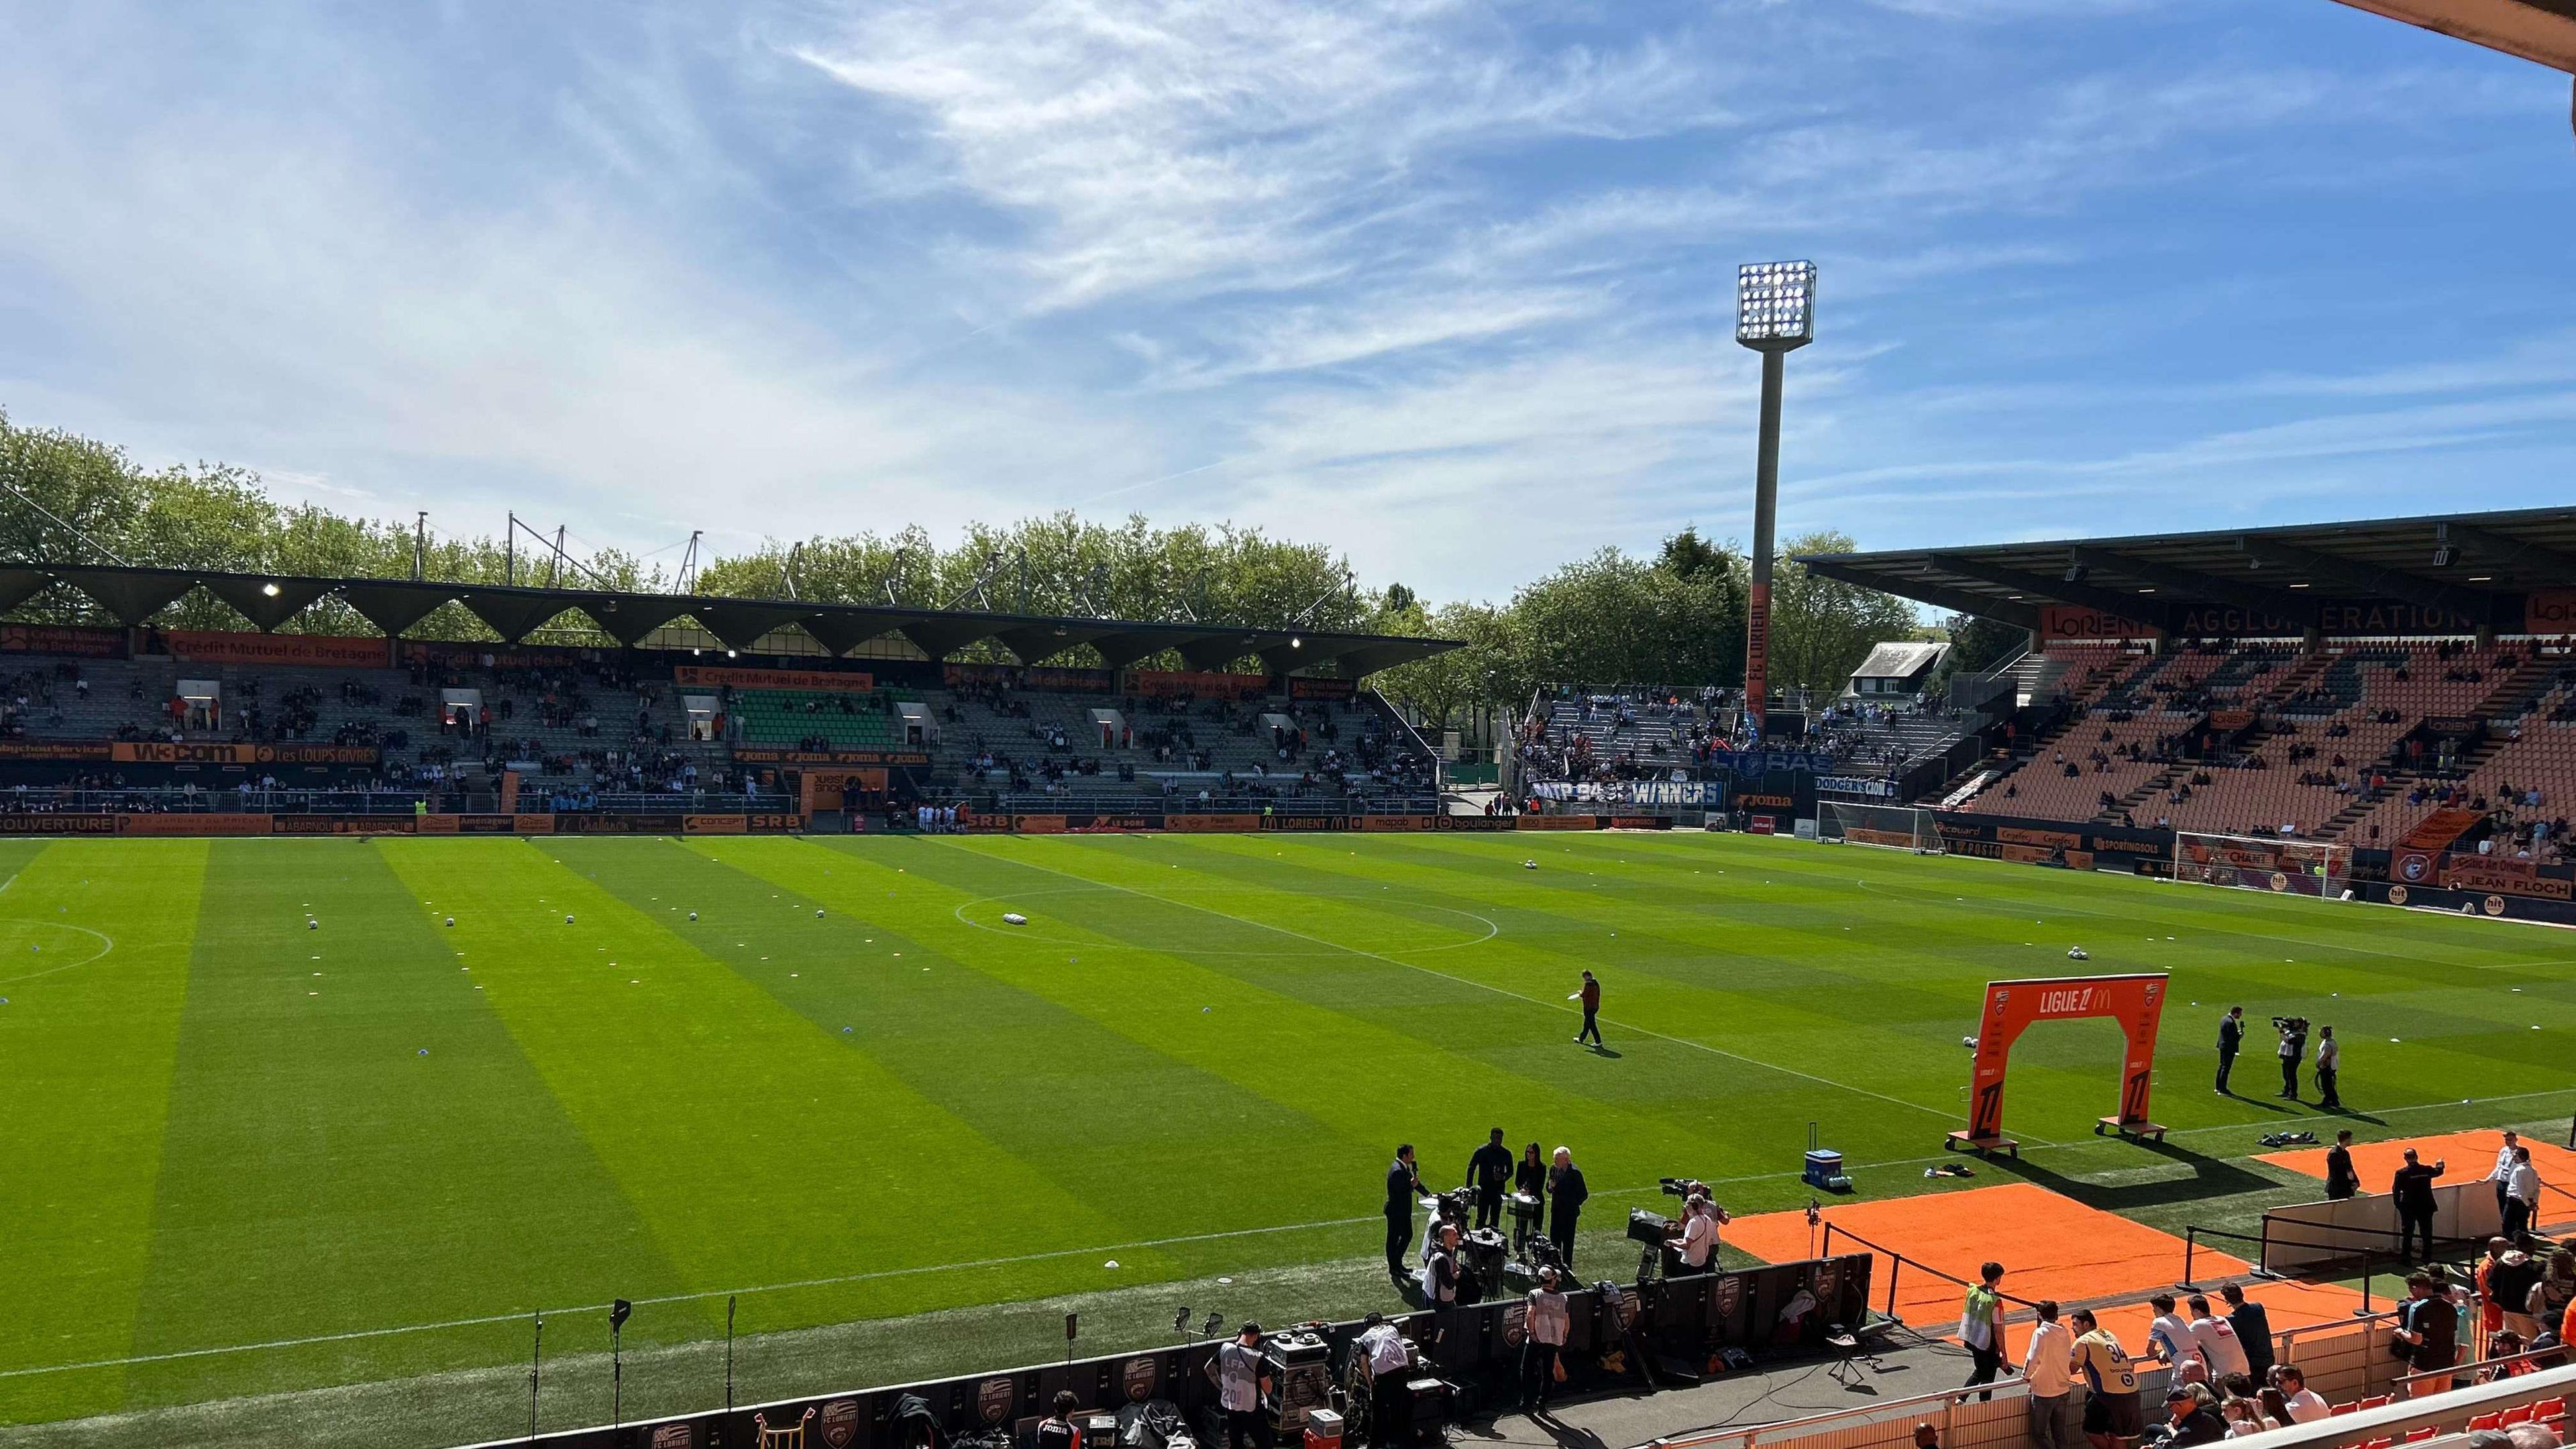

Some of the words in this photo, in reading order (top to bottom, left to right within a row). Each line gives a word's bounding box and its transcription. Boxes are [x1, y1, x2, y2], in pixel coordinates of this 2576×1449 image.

[174, 639, 226, 655] Crédit
[230, 643, 288, 657] Mutuel
[292, 645, 312, 657] de
[316, 647, 386, 663] Bretagne
[705, 672, 745, 684] Crédit
[746, 674, 791, 685] Mutuel
[794, 675, 808, 686] de
[812, 676, 867, 688] Bretagne
[2212, 712, 2253, 724] LORIENT
[2428, 718, 2479, 731] LORIENT
[276, 749, 296, 762] Les
[299, 748, 335, 763] LOUPS
[338, 747, 377, 763] GIVRÉS
[744, 751, 779, 763] joma
[796, 752, 830, 763] joma
[846, 753, 880, 763] joma
[896, 753, 927, 764] joma
[1815, 778, 1866, 792] DODGER'S
[1631, 781, 1718, 804] WINNERS
[1750, 794, 1794, 808] joma
[0, 818, 111, 831] OUVERTURE
[286, 822, 332, 832] ABARNOU
[460, 816, 513, 826] Aménageur
[752, 816, 800, 827] SRB
[967, 815, 1008, 827] SRB
[1282, 818, 1327, 828] LORIENT
[1454, 816, 1513, 828] boulanger
[2001, 829, 2031, 843] Cegelec
[2043, 834, 2073, 847] Cegelec
[1968, 842, 2002, 857] POSTO
[2104, 839, 2158, 854] SPORTINGSOLS
[2273, 874, 2284, 883] hit
[2467, 875, 2506, 890] JEAN
[2514, 881, 2569, 896] FLOCH
[2391, 888, 2406, 898] hit
[2487, 897, 2502, 908] hit
[2039, 990, 2080, 1014] LIGUE
[2106, 1343, 2129, 1364] 34
[1225, 1358, 1246, 1370] LFP
[823, 1416, 831, 1424] FC
[832, 1413, 856, 1423] LORIENT
[1043, 1424, 1068, 1436] joma
[663, 1438, 689, 1448] LORIENT
